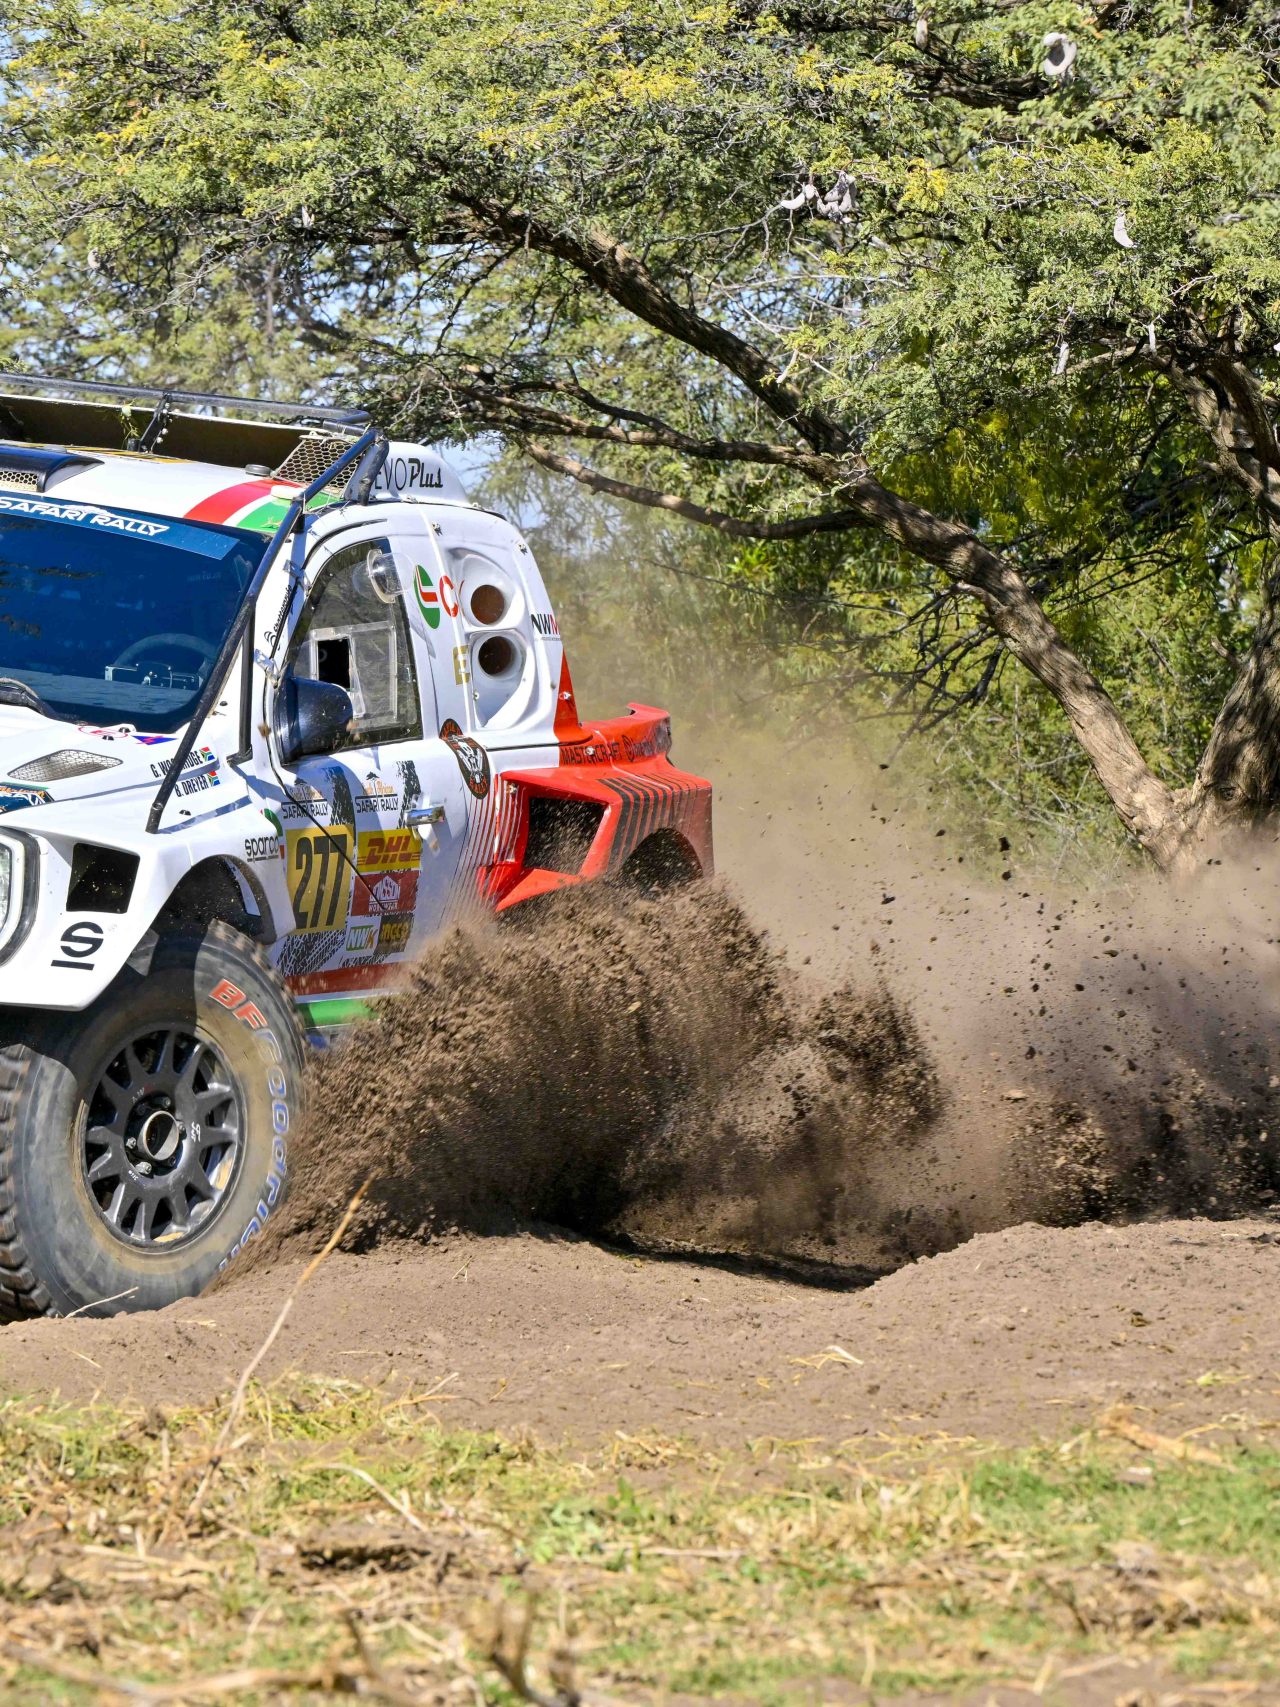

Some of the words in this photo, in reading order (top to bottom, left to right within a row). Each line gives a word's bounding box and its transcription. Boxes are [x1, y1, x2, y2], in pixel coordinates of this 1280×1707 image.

[90, 512, 170, 536] RALLY
[181, 775, 209, 795] DREYER
[355, 796, 380, 813] SAFARI
[381, 795, 399, 811] RALLY
[245, 836, 279, 862] sparco
[365, 836, 411, 865] DHL
[293, 834, 348, 929] 277
